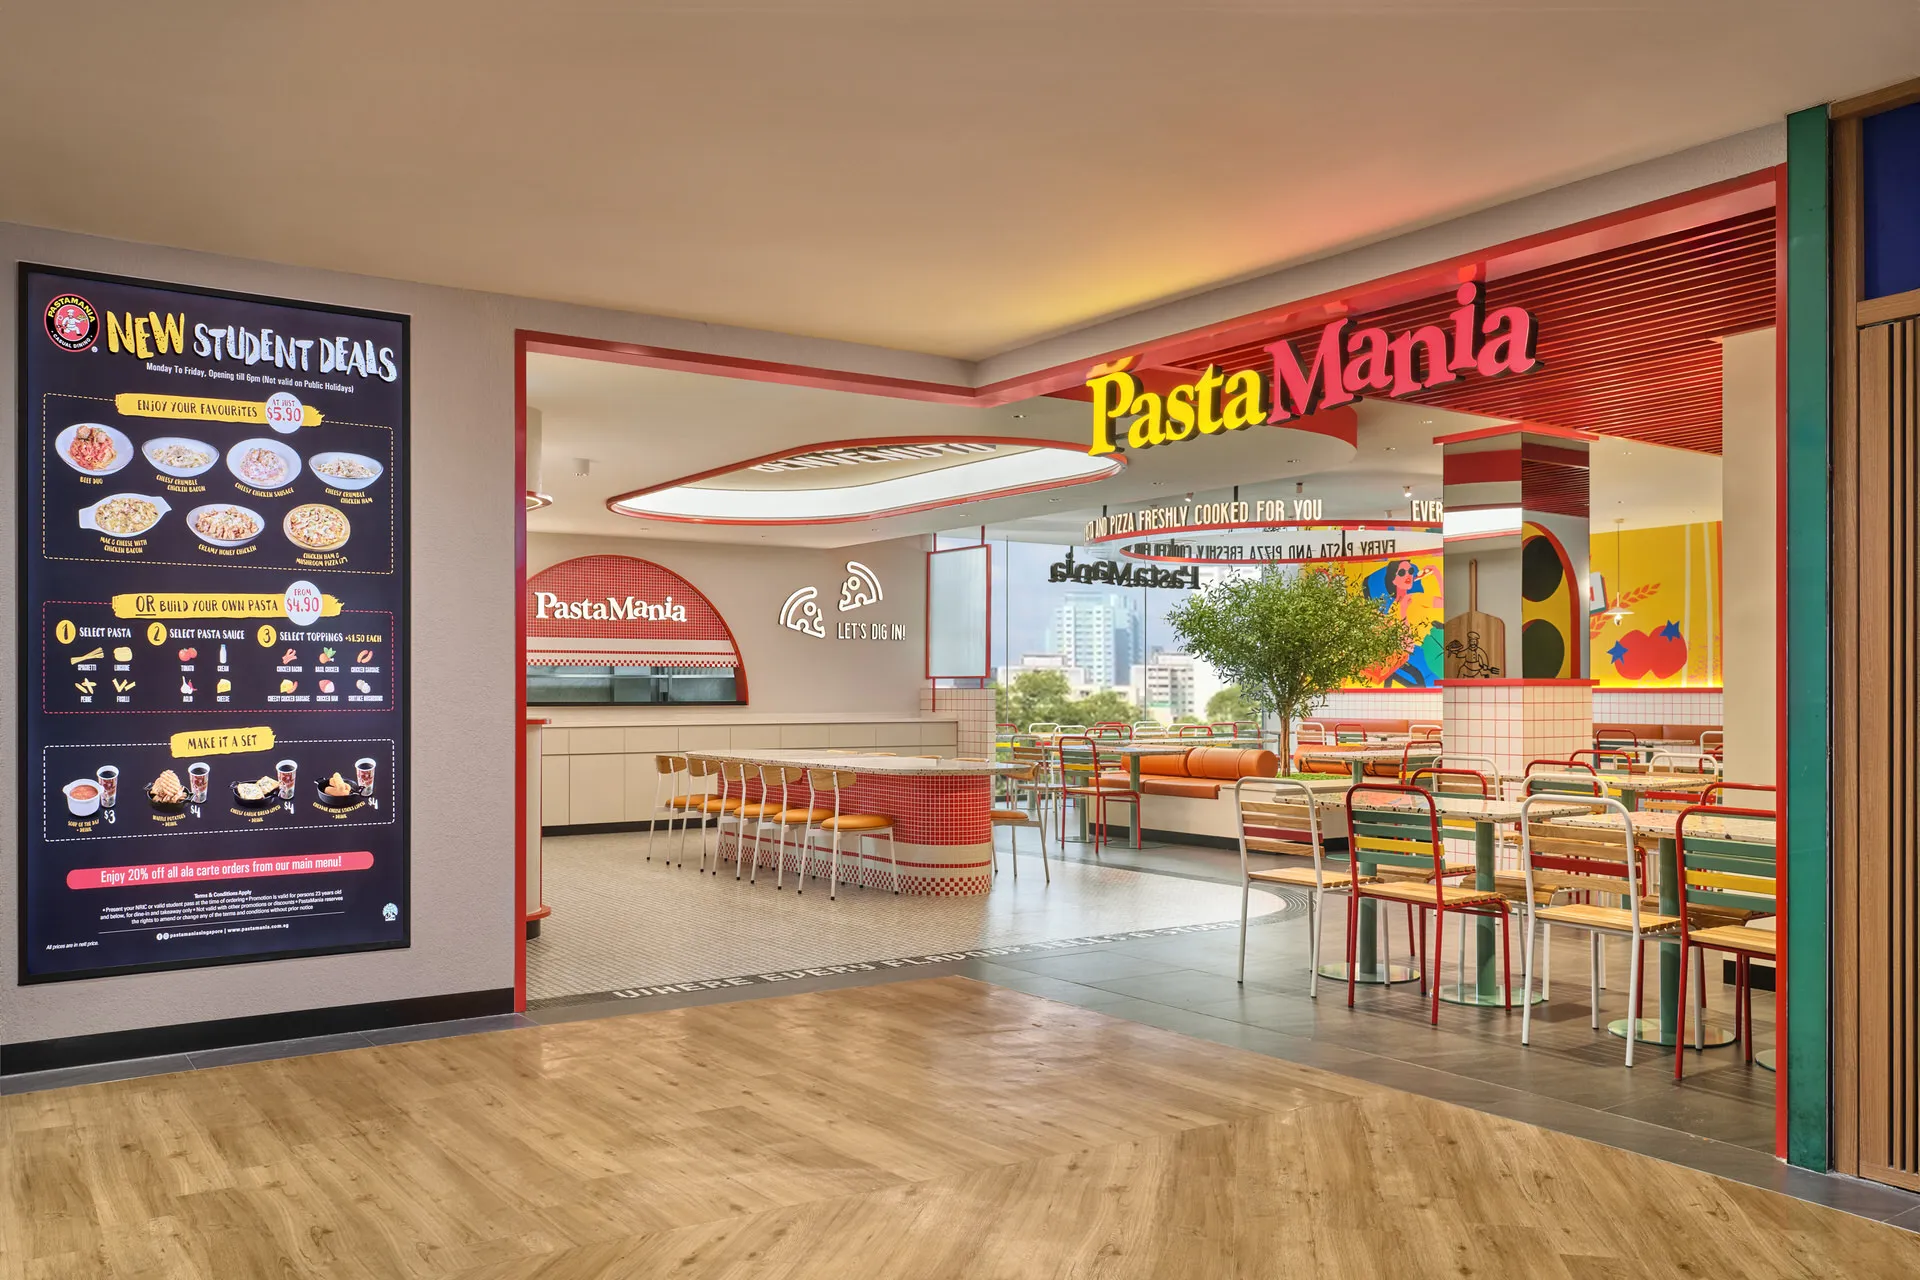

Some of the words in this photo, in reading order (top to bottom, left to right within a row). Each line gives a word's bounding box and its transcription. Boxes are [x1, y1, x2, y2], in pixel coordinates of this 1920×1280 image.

[48, 297, 95, 322] PASTAMANIA
[53, 334, 72, 348] CASUAL
[72, 338, 91, 349] DINING
[106, 311, 185, 359] NEW
[193, 325, 314, 371] STUDENT
[319, 336, 397, 383] DEALS
[1086, 281, 1542, 455] PastaMania
[146, 362, 172, 374] Monday
[174, 365, 183, 374] To
[184, 366, 207, 378] Friday,
[208, 369, 234, 381] Opening
[236, 372, 245, 380] till
[246, 373, 260, 383] 6pm
[262, 375, 276, 385] (Not
[278, 378, 293, 387] valid
[304, 380, 323, 390] Public
[325, 383, 354, 393] Holidays)
[172, 402, 197, 414] YOUR
[267, 406, 301, 422] $5.90
[1110, 512, 1135, 536] PIZZA
[1138, 506, 1189, 531] FRESHLY
[1194, 502, 1249, 526] COOKED
[1256, 500, 1285, 522] FOR
[1294, 499, 1322, 521] YOU
[1411, 500, 1444, 522] EVER
[294, 588, 312, 596] FROM
[136, 595, 156, 613] OR
[193, 600, 218, 612] YOUR
[222, 600, 245, 612] OWN
[250, 600, 278, 612] PASTA
[286, 597, 319, 613] $4.90
[534, 592, 687, 623] PastaMania
[62, 624, 69, 640] 1
[79, 627, 106, 638] SELECT
[107, 628, 132, 638] PASTA
[153, 626, 161, 642] 2
[170, 628, 196, 639] SELECT
[197, 629, 221, 640] PASTA
[222, 630, 245, 640] SAUCE
[263, 628, 271, 644] 3
[280, 632, 305, 642] SELECT
[366, 634, 382, 643] EACH
[837, 622, 867, 640] LET'S
[871, 623, 888, 640] DIG
[891, 624, 906, 641] IN!
[188, 738, 216, 750] MAKE
[232, 736, 239, 748] A
[242, 734, 258, 747] SET
[190, 804, 201, 819] $4
[284, 801, 295, 815] $4
[368, 797, 379, 810] $4
[104, 810, 116, 824] $3
[101, 870, 126, 884] Enjoy
[128, 868, 149, 881] 20%
[152, 866, 165, 880] off
[168, 866, 179, 878] all
[181, 865, 194, 877] ala
[197, 864, 220, 877] carte
[222, 862, 250, 875] orders
[252, 861, 273, 873] from
[276, 862, 289, 871] our
[292, 858, 313, 870] main
[315, 856, 342, 869] menu!
[213, 890, 238, 898] Conditions
[613, 976, 754, 999] WHERE
[759, 962, 876, 983] EVERY
